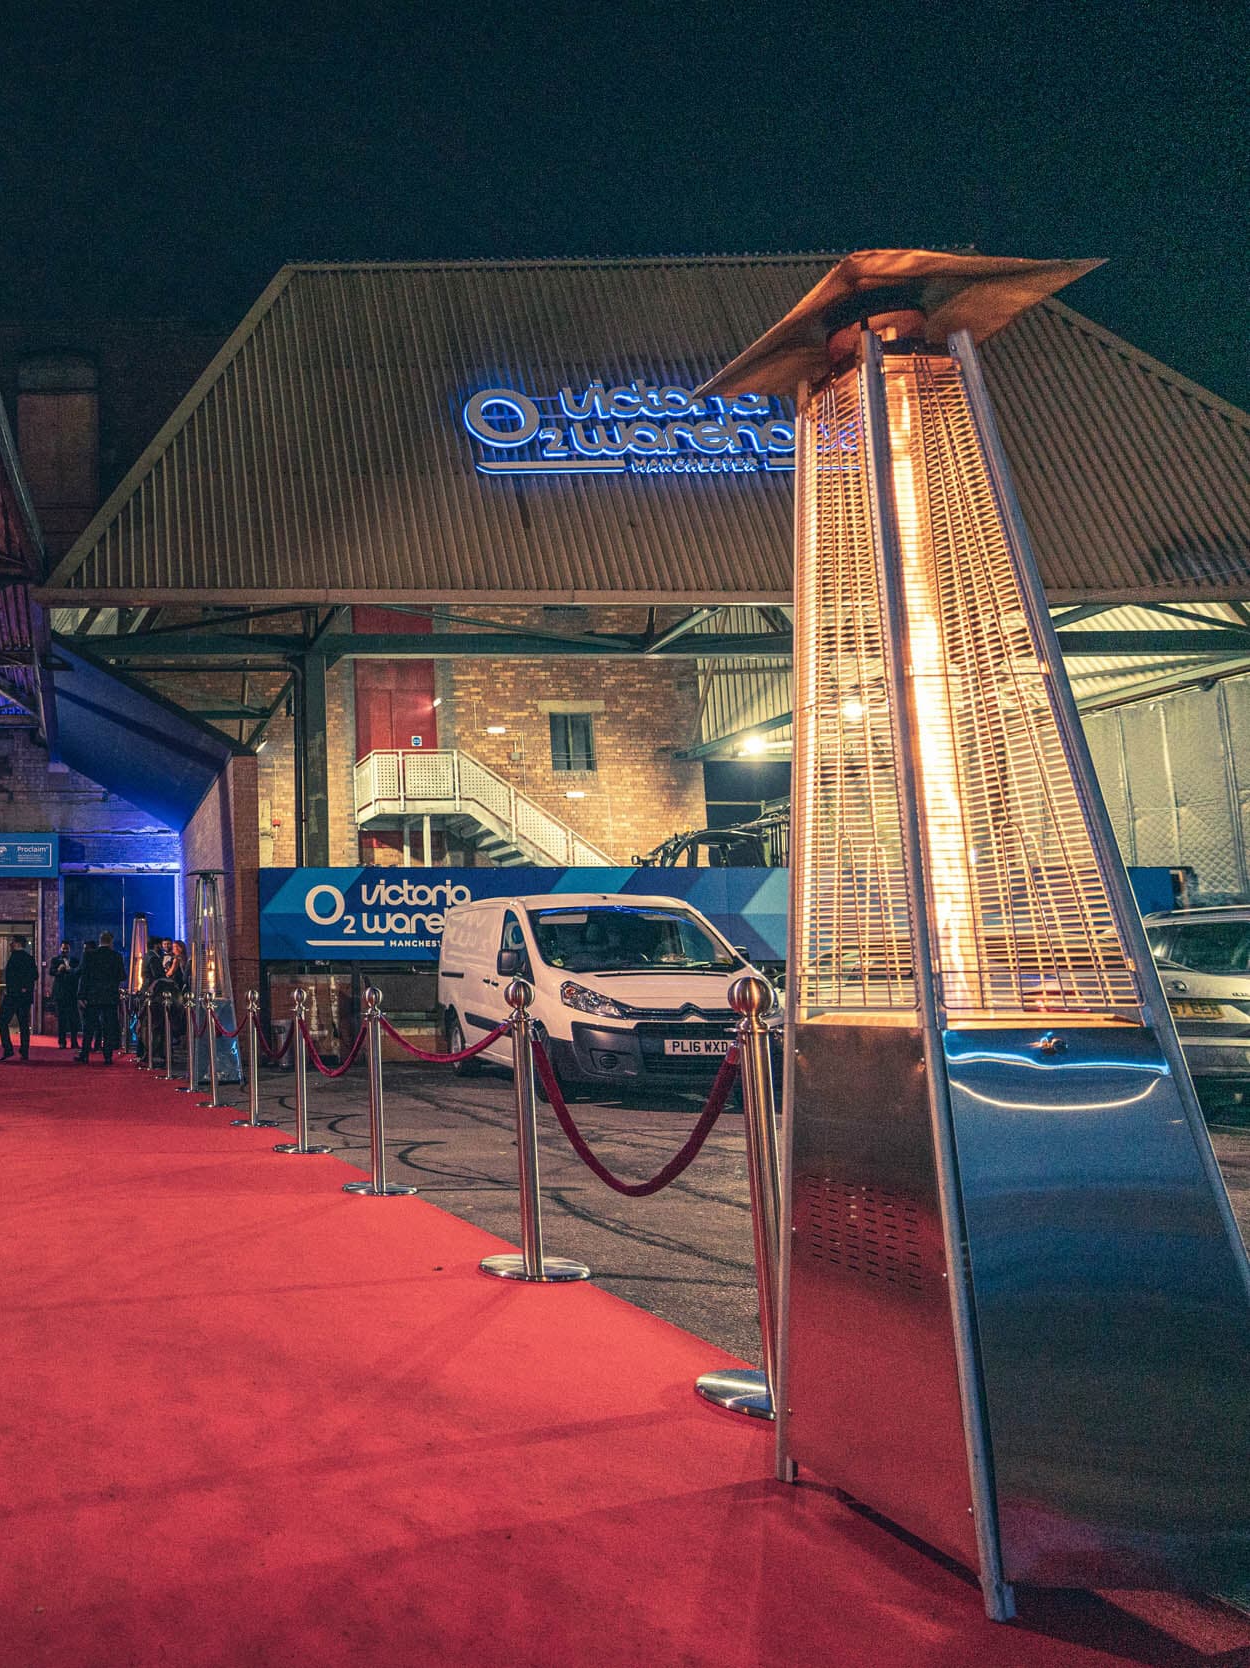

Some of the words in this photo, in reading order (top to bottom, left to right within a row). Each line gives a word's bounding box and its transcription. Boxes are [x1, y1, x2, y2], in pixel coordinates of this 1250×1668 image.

[361, 879, 472, 906] victoria
[672, 1041, 701, 1053] PL16
[704, 1041, 728, 1053] WXD
